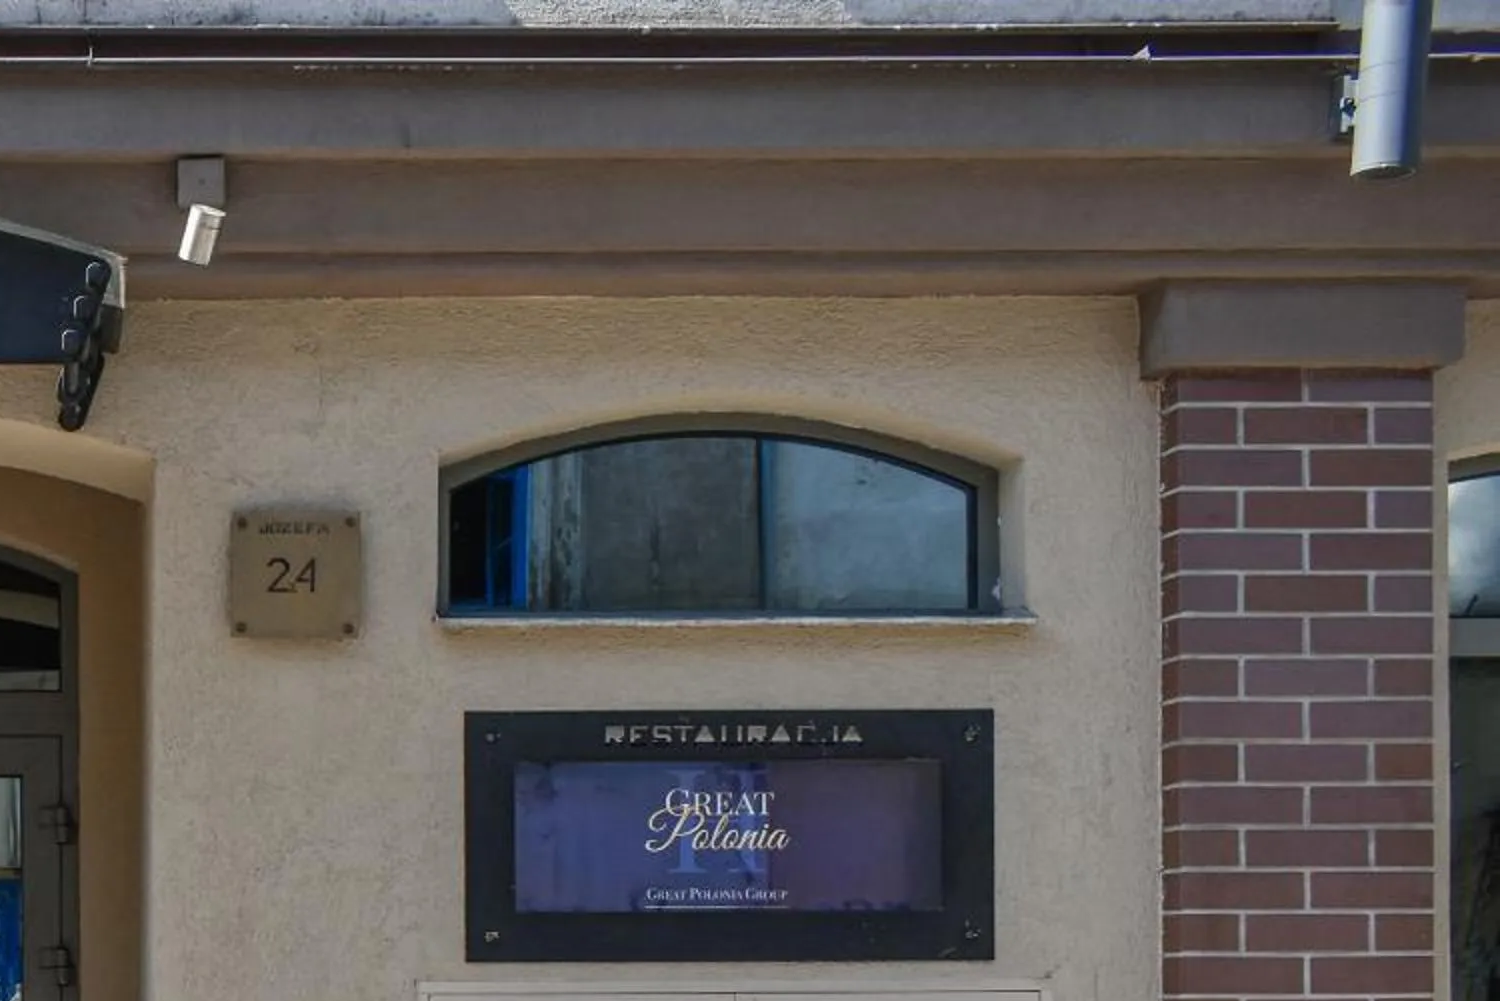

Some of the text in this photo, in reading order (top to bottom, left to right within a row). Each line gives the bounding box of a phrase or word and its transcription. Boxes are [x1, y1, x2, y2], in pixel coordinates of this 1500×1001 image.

[266, 557, 317, 593] 24
[603, 724, 863, 743] RESTAURACJA
[665, 788, 775, 816] GREAT
[645, 804, 791, 853] Polonia
[646, 887, 788, 901] GREAT POLONIA GROUP
